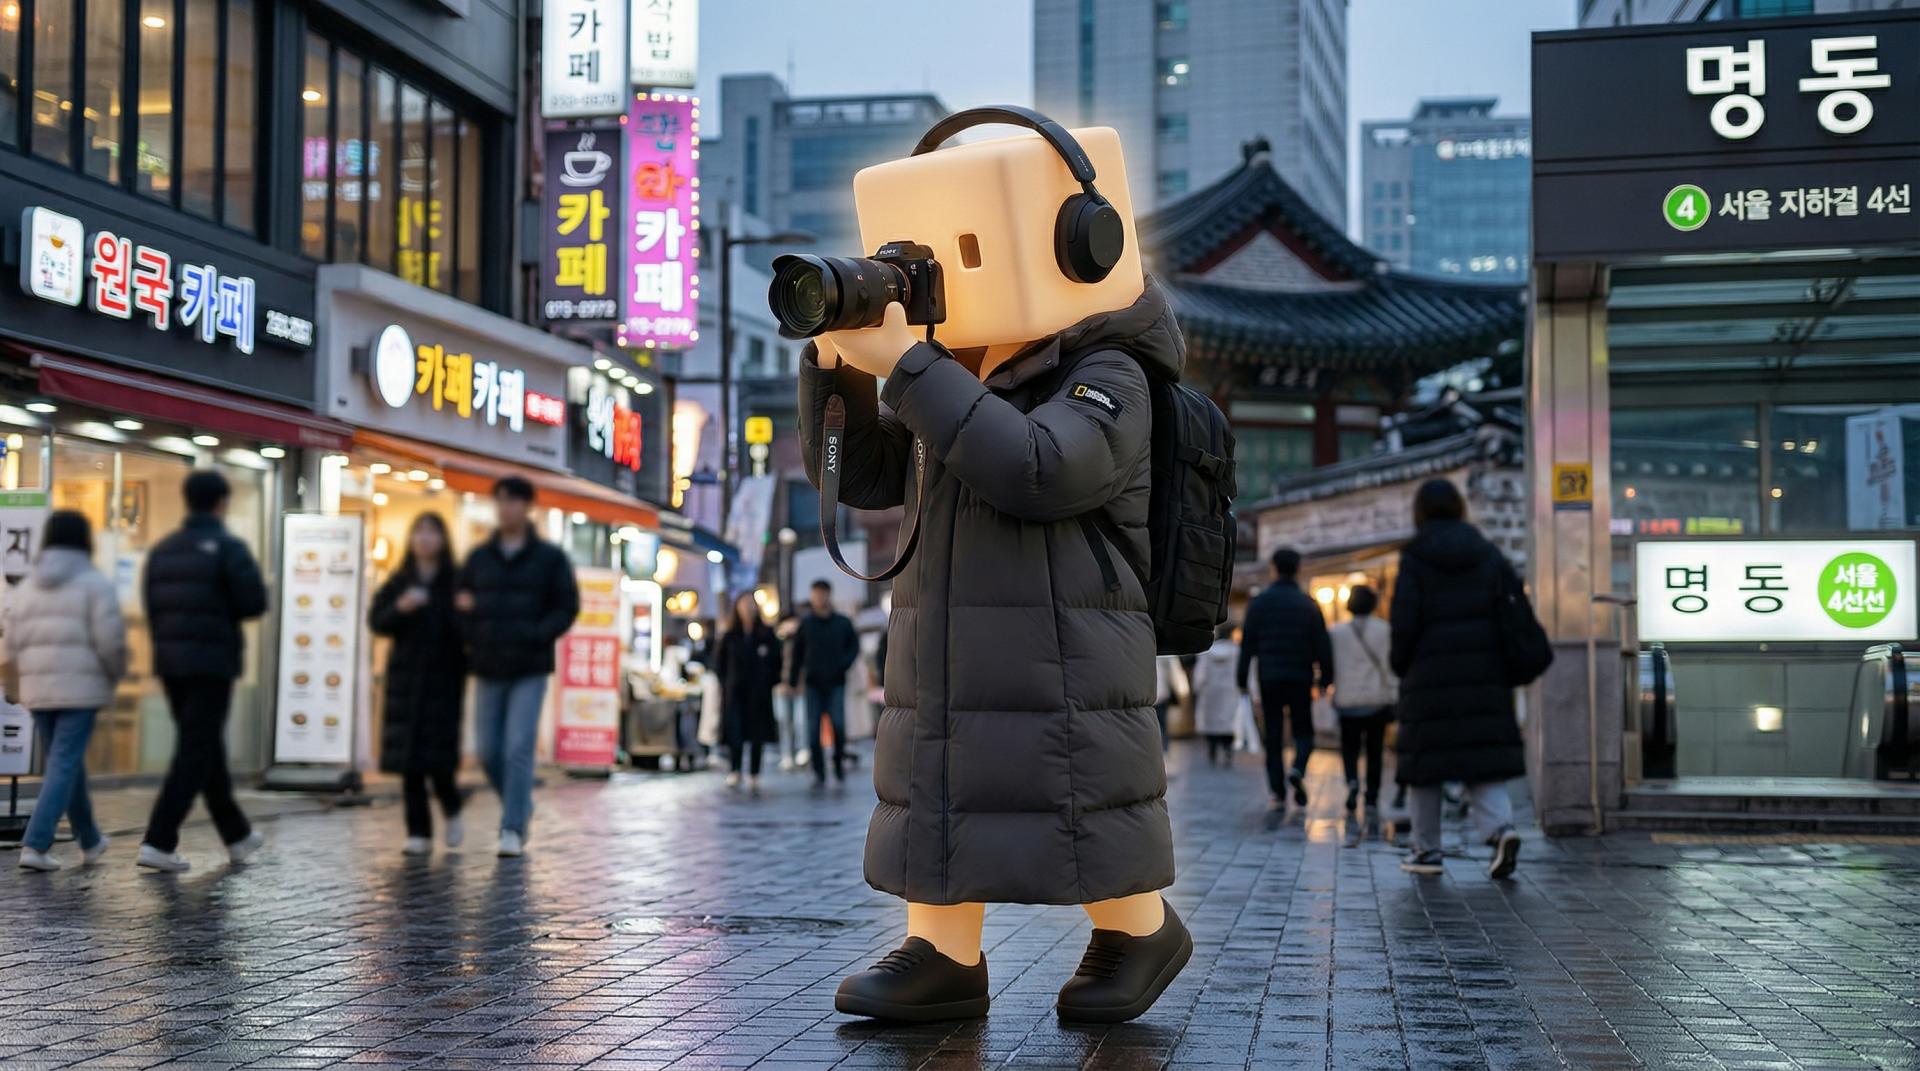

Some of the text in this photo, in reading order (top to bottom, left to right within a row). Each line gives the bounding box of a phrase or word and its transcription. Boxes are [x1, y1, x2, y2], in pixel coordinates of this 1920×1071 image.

[1677, 195, 1697, 220] 4
[1718, 189, 1772, 221] 서울
[1866, 183, 1911, 214] 4선
[556, 189, 610, 296] 카페
[634, 207, 686, 312] 카페
[91, 231, 174, 331] 원국
[179, 264, 256, 355] 카페
[828, 436, 838, 474] SONY
[1833, 563, 1879, 588] 서울
